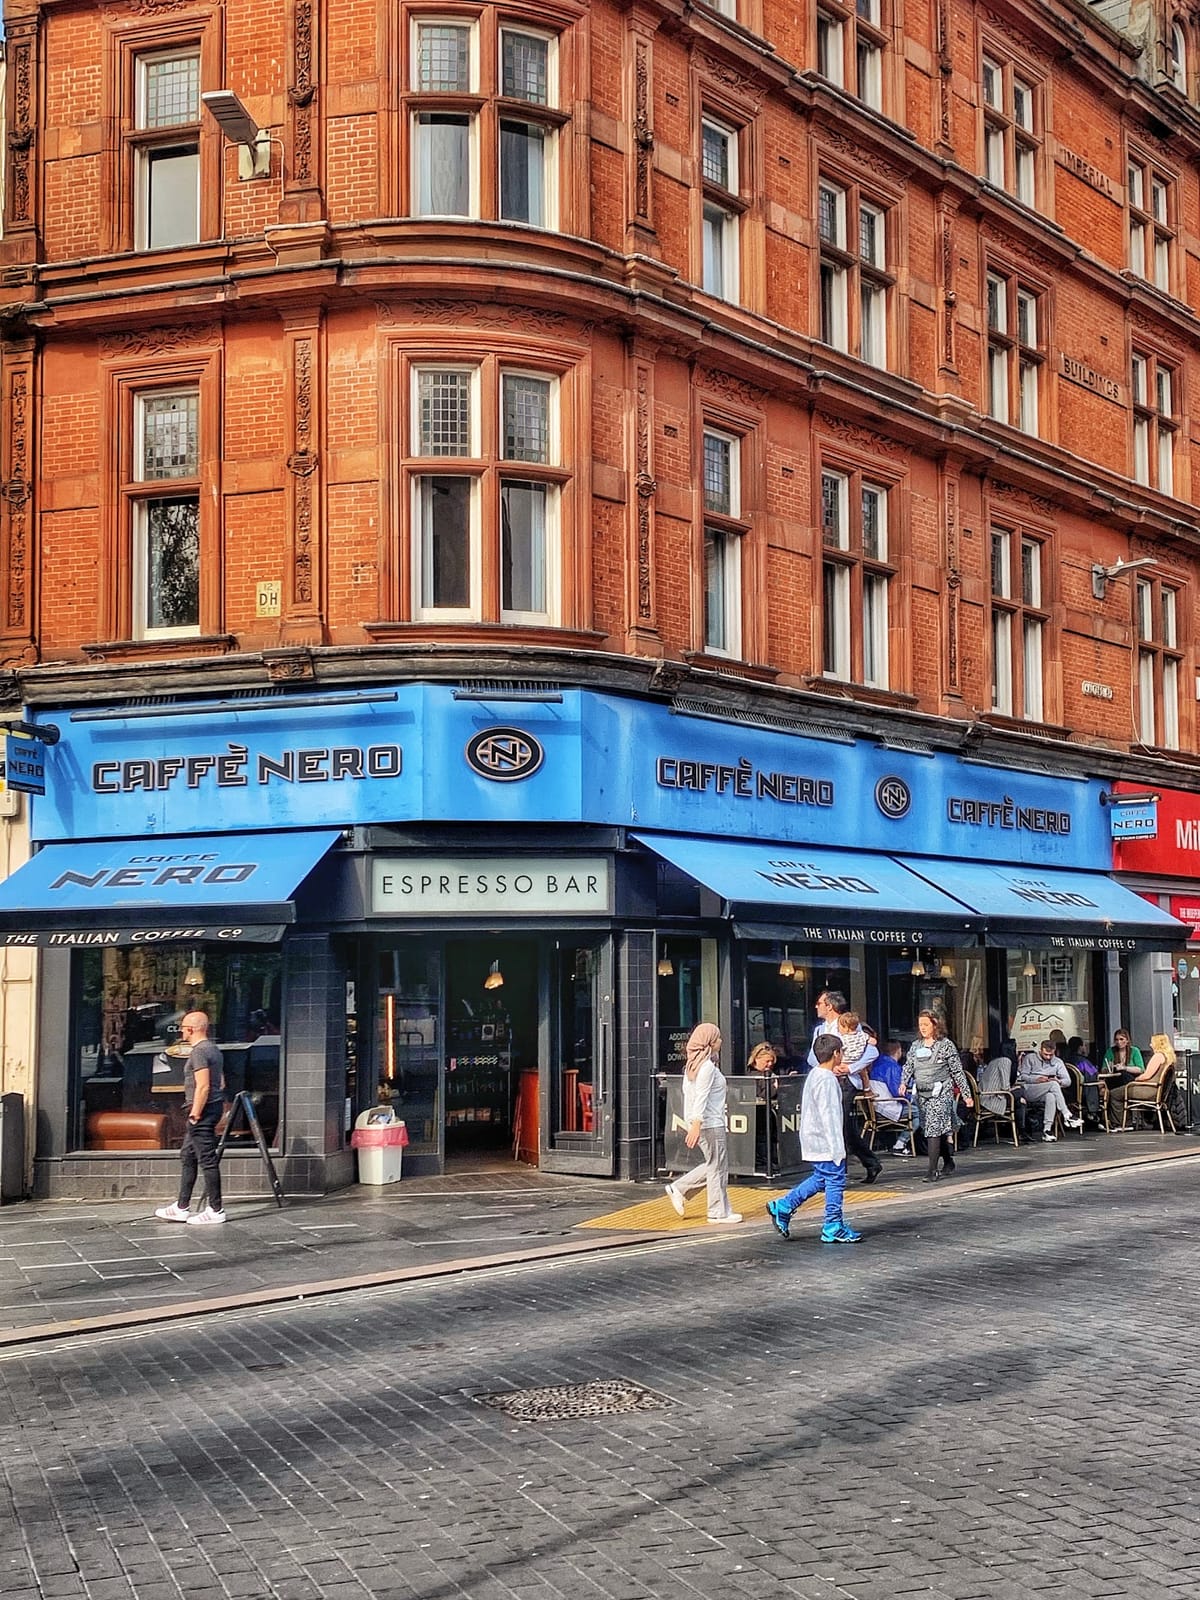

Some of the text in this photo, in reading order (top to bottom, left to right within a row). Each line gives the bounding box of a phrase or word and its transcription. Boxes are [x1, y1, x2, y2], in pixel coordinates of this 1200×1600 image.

[1063, 148, 1113, 195] IMPERIAL
[92, 743, 403, 794] CAFFÈ NERO
[656, 756, 834, 807] CAFFÈ NERO
[948, 795, 1072, 836] CAFFÈ NERO
[1113, 819, 1154, 829] NERO
[48, 862, 257, 890] NERO
[383, 875, 598, 894] ESPRESSO BAR
[755, 869, 880, 894] NERO
[1008, 888, 1099, 908] NERO
[5, 934, 38, 945] THE
[48, 932, 120, 945] ITALIAN
[130, 928, 206, 942] COFFEE
[803, 927, 822, 938] THE
[828, 928, 864, 941] ITALIAN
[870, 930, 906, 943] COFFEE
[1050, 936, 1065, 947] THE
[1068, 937, 1094, 948] ITALIAN
[1098, 938, 1125, 949] COFFEE
